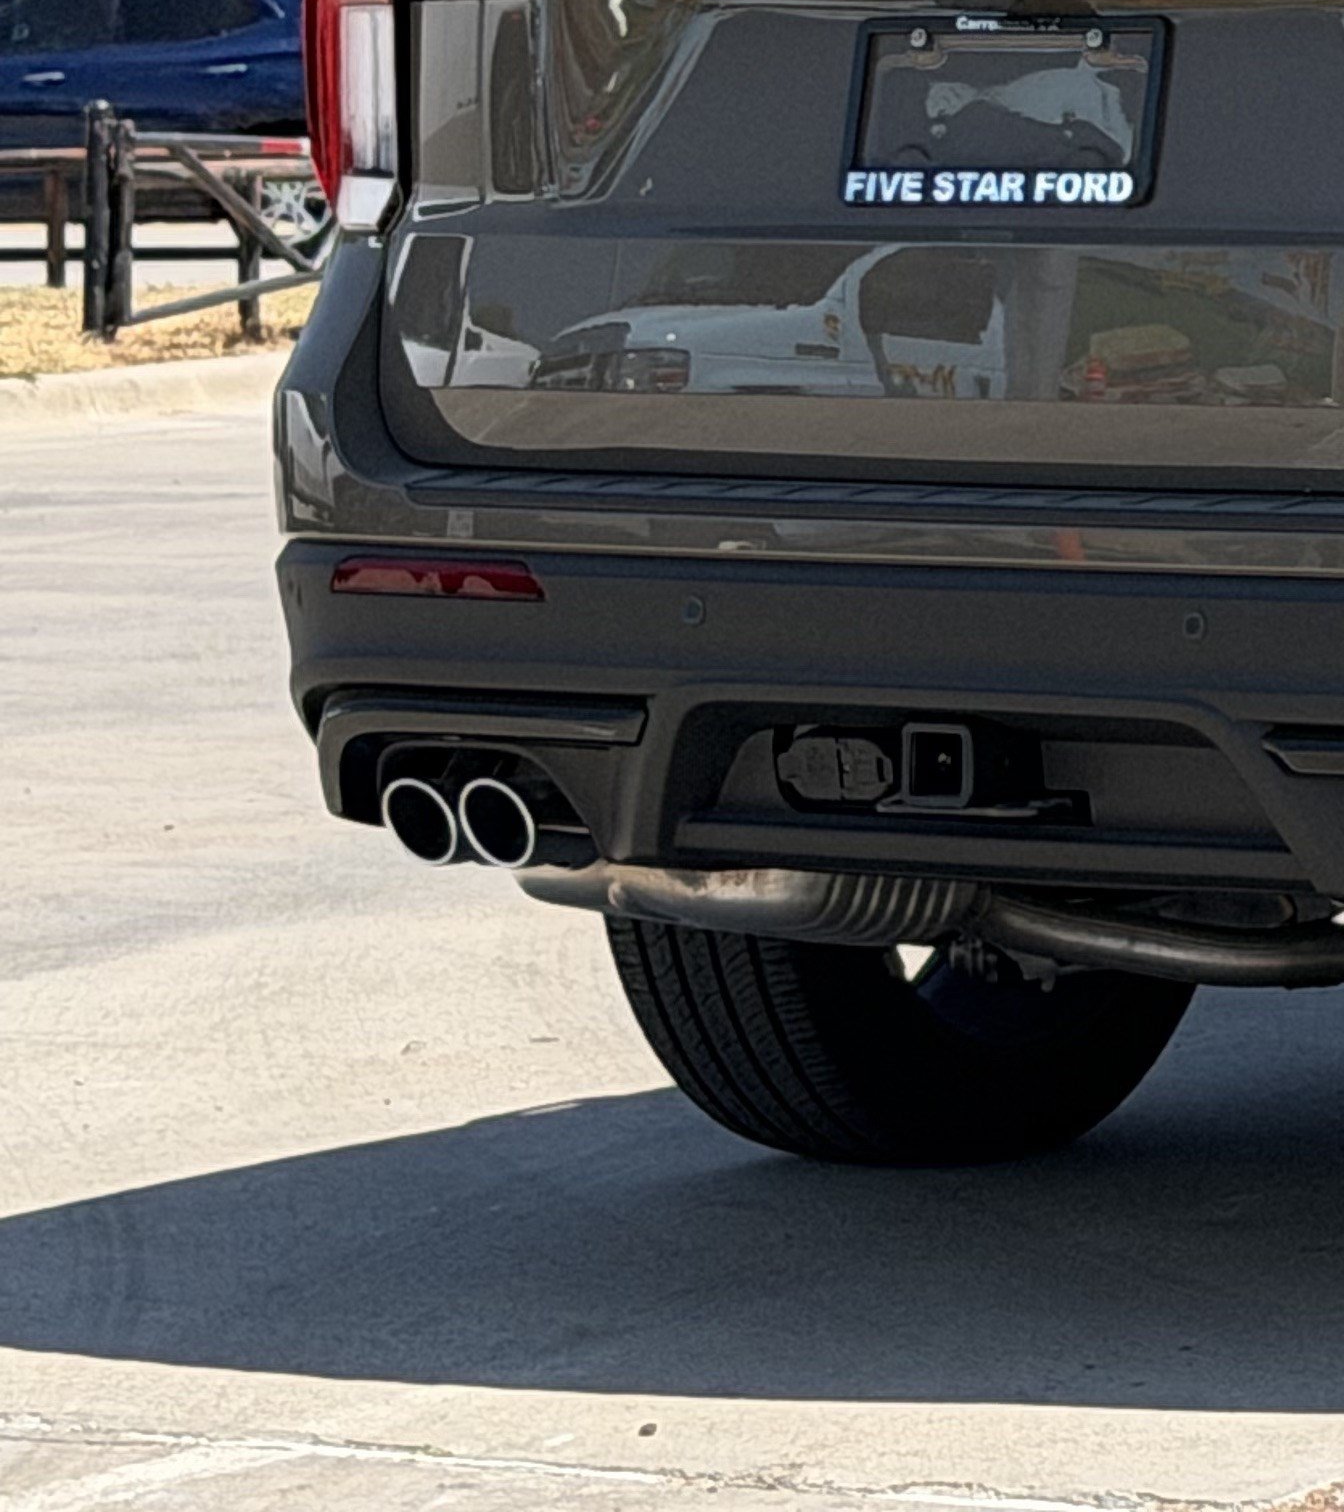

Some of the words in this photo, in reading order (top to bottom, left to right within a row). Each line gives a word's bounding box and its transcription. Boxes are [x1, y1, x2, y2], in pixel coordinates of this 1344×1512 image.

[844, 170, 925, 203] FIVE
[931, 170, 1027, 203] STAR
[1033, 170, 1135, 204] FORD
